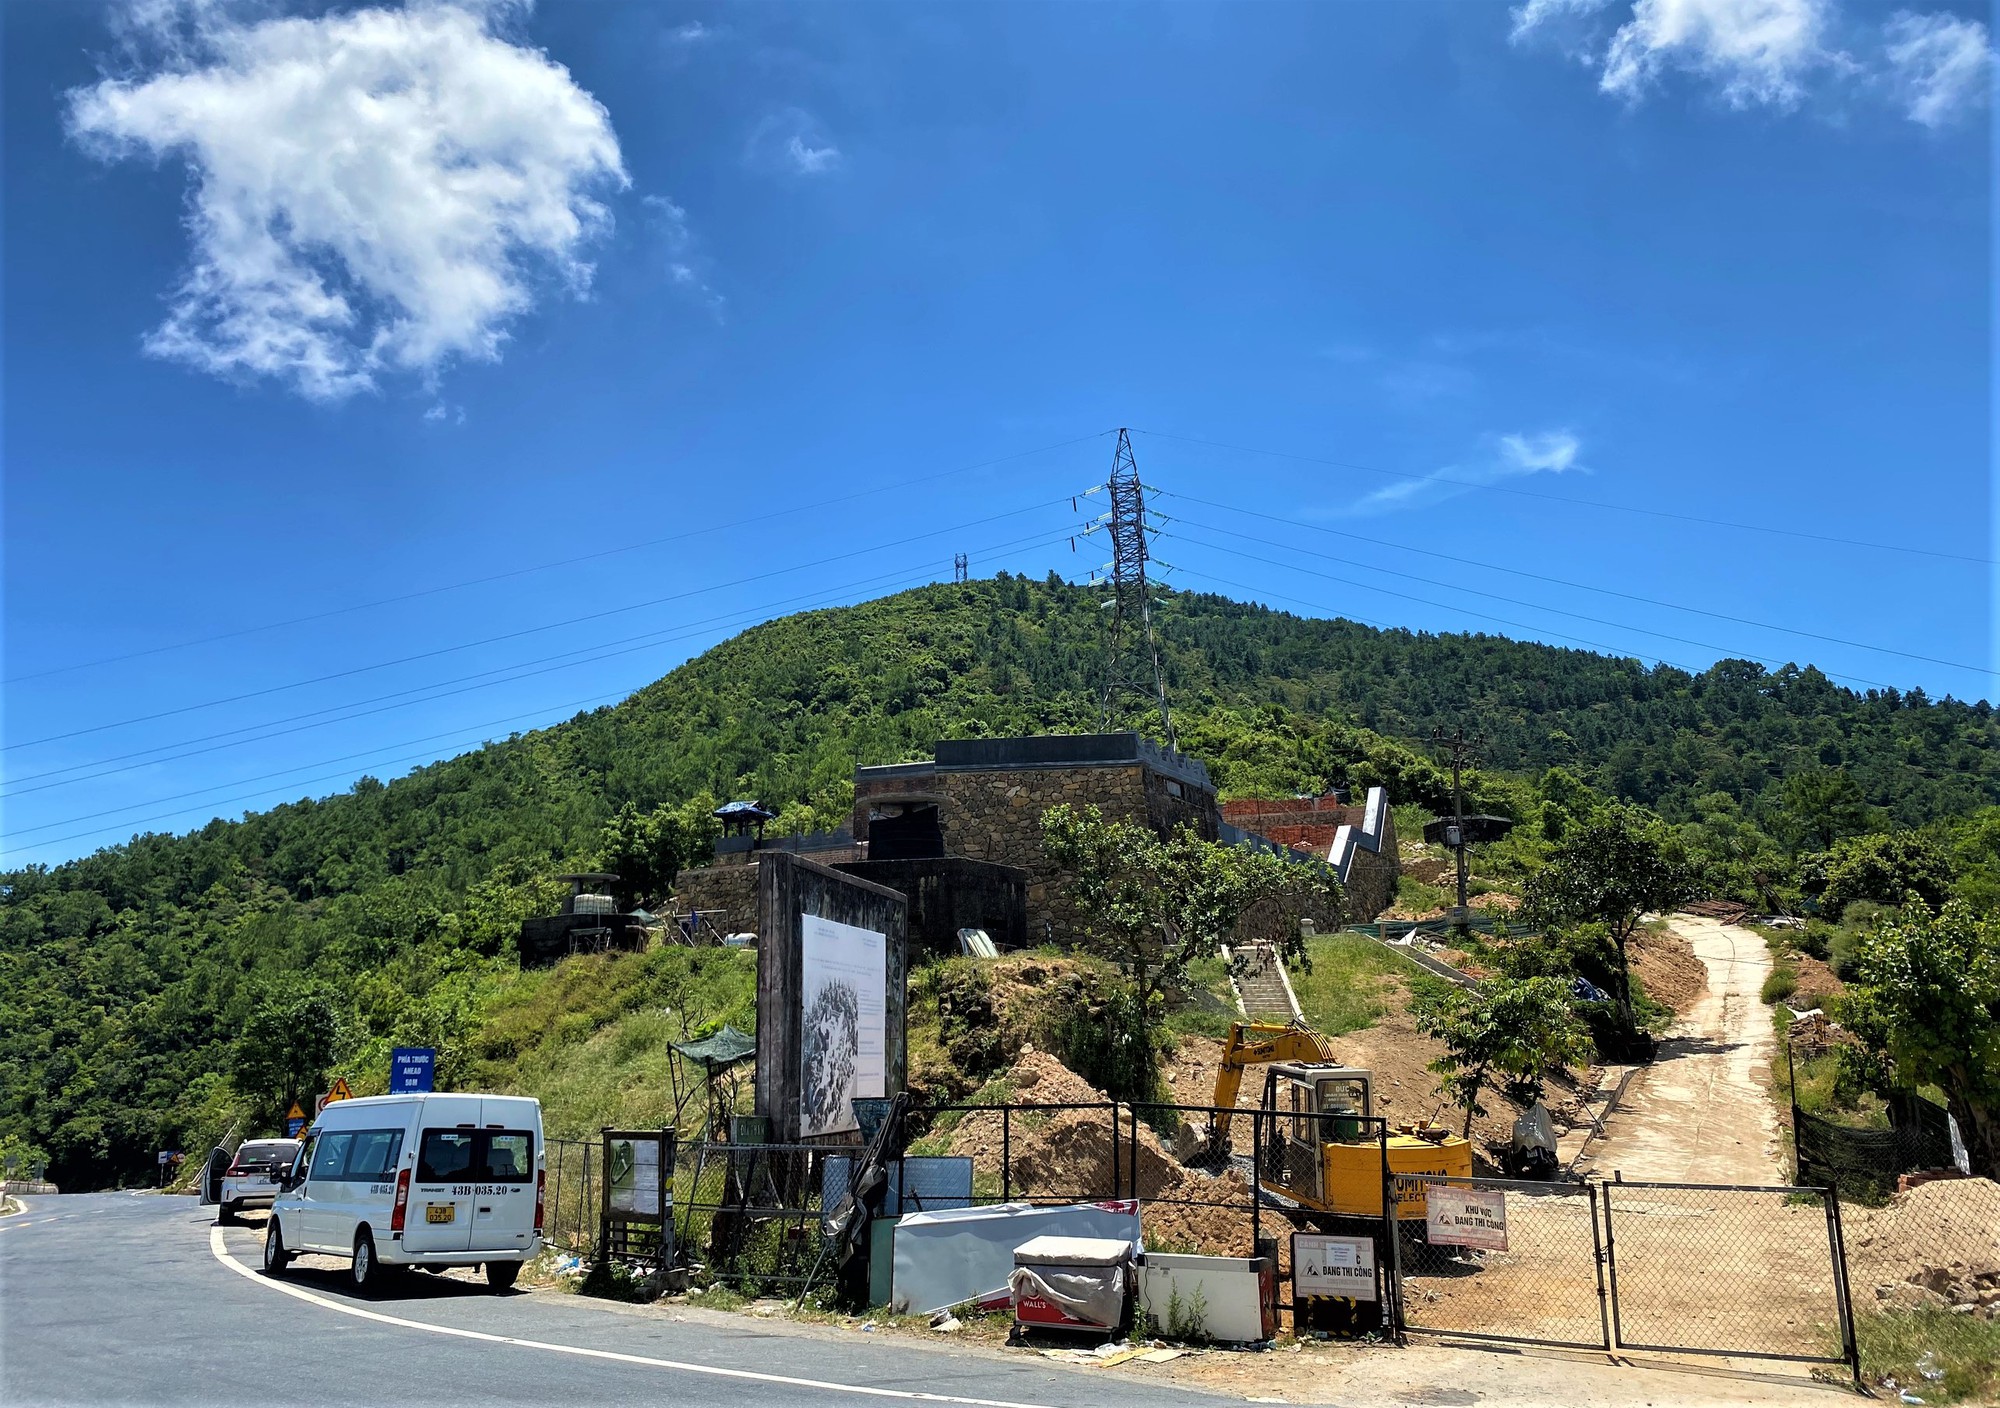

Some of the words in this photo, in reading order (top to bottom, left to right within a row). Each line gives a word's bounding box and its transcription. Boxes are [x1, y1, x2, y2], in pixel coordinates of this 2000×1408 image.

[397, 1054, 410, 1063] PHÍA
[405, 1078, 418, 1086] 50M
[1465, 1205, 1479, 1215] KHU
[1455, 1216, 1473, 1226] ĐANG
[1474, 1217, 1485, 1227] THI
[1486, 1219, 1504, 1231] CÔNG
[1322, 1266, 1340, 1276] ĐANG
[1342, 1267, 1352, 1277] THI
[1354, 1266, 1372, 1277] CÔNG
[1022, 1300, 1046, 1309] WALL'S
